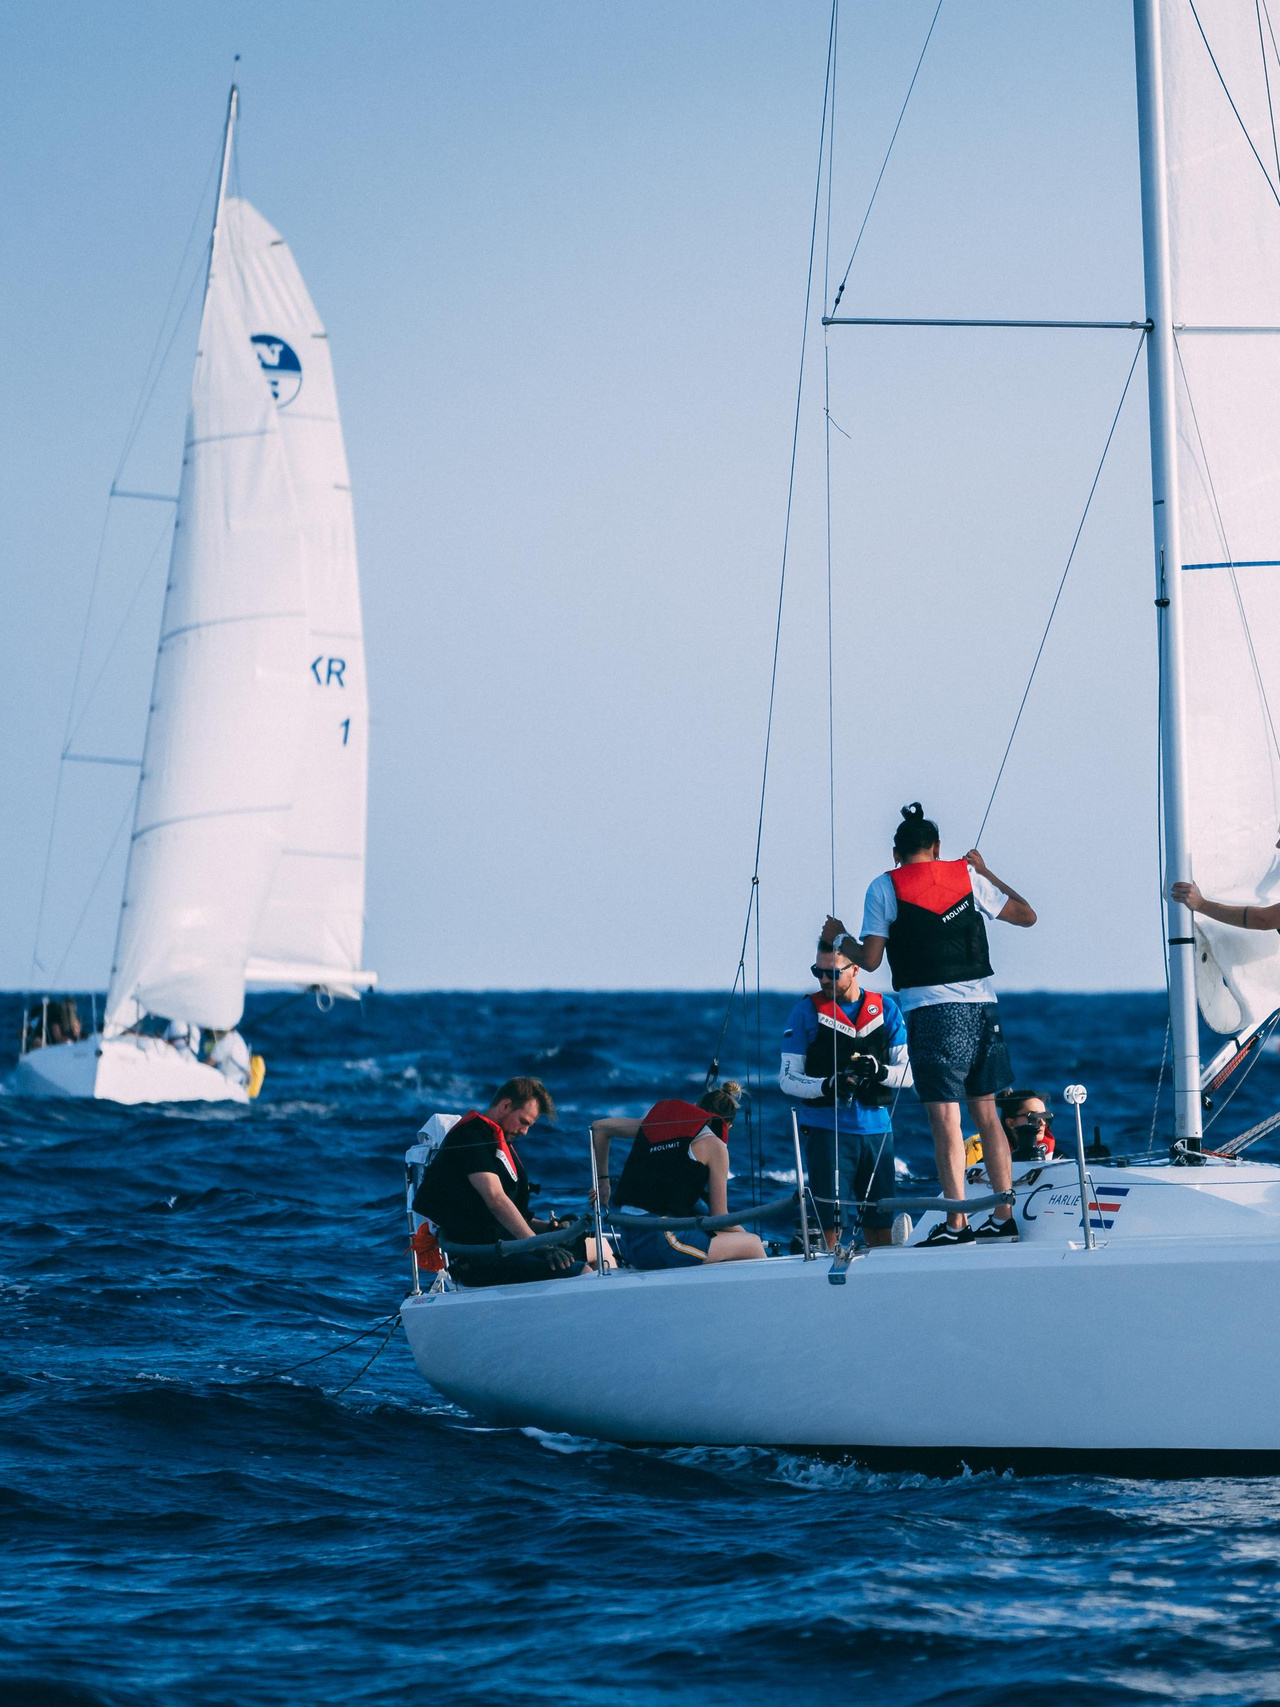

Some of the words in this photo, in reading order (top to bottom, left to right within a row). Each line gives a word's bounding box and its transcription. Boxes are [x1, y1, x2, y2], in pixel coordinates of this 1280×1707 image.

[339, 718, 350, 746] 1
[941, 900, 970, 924] PROLIMIT
[649, 1141, 680, 1154] PROLIMIT
